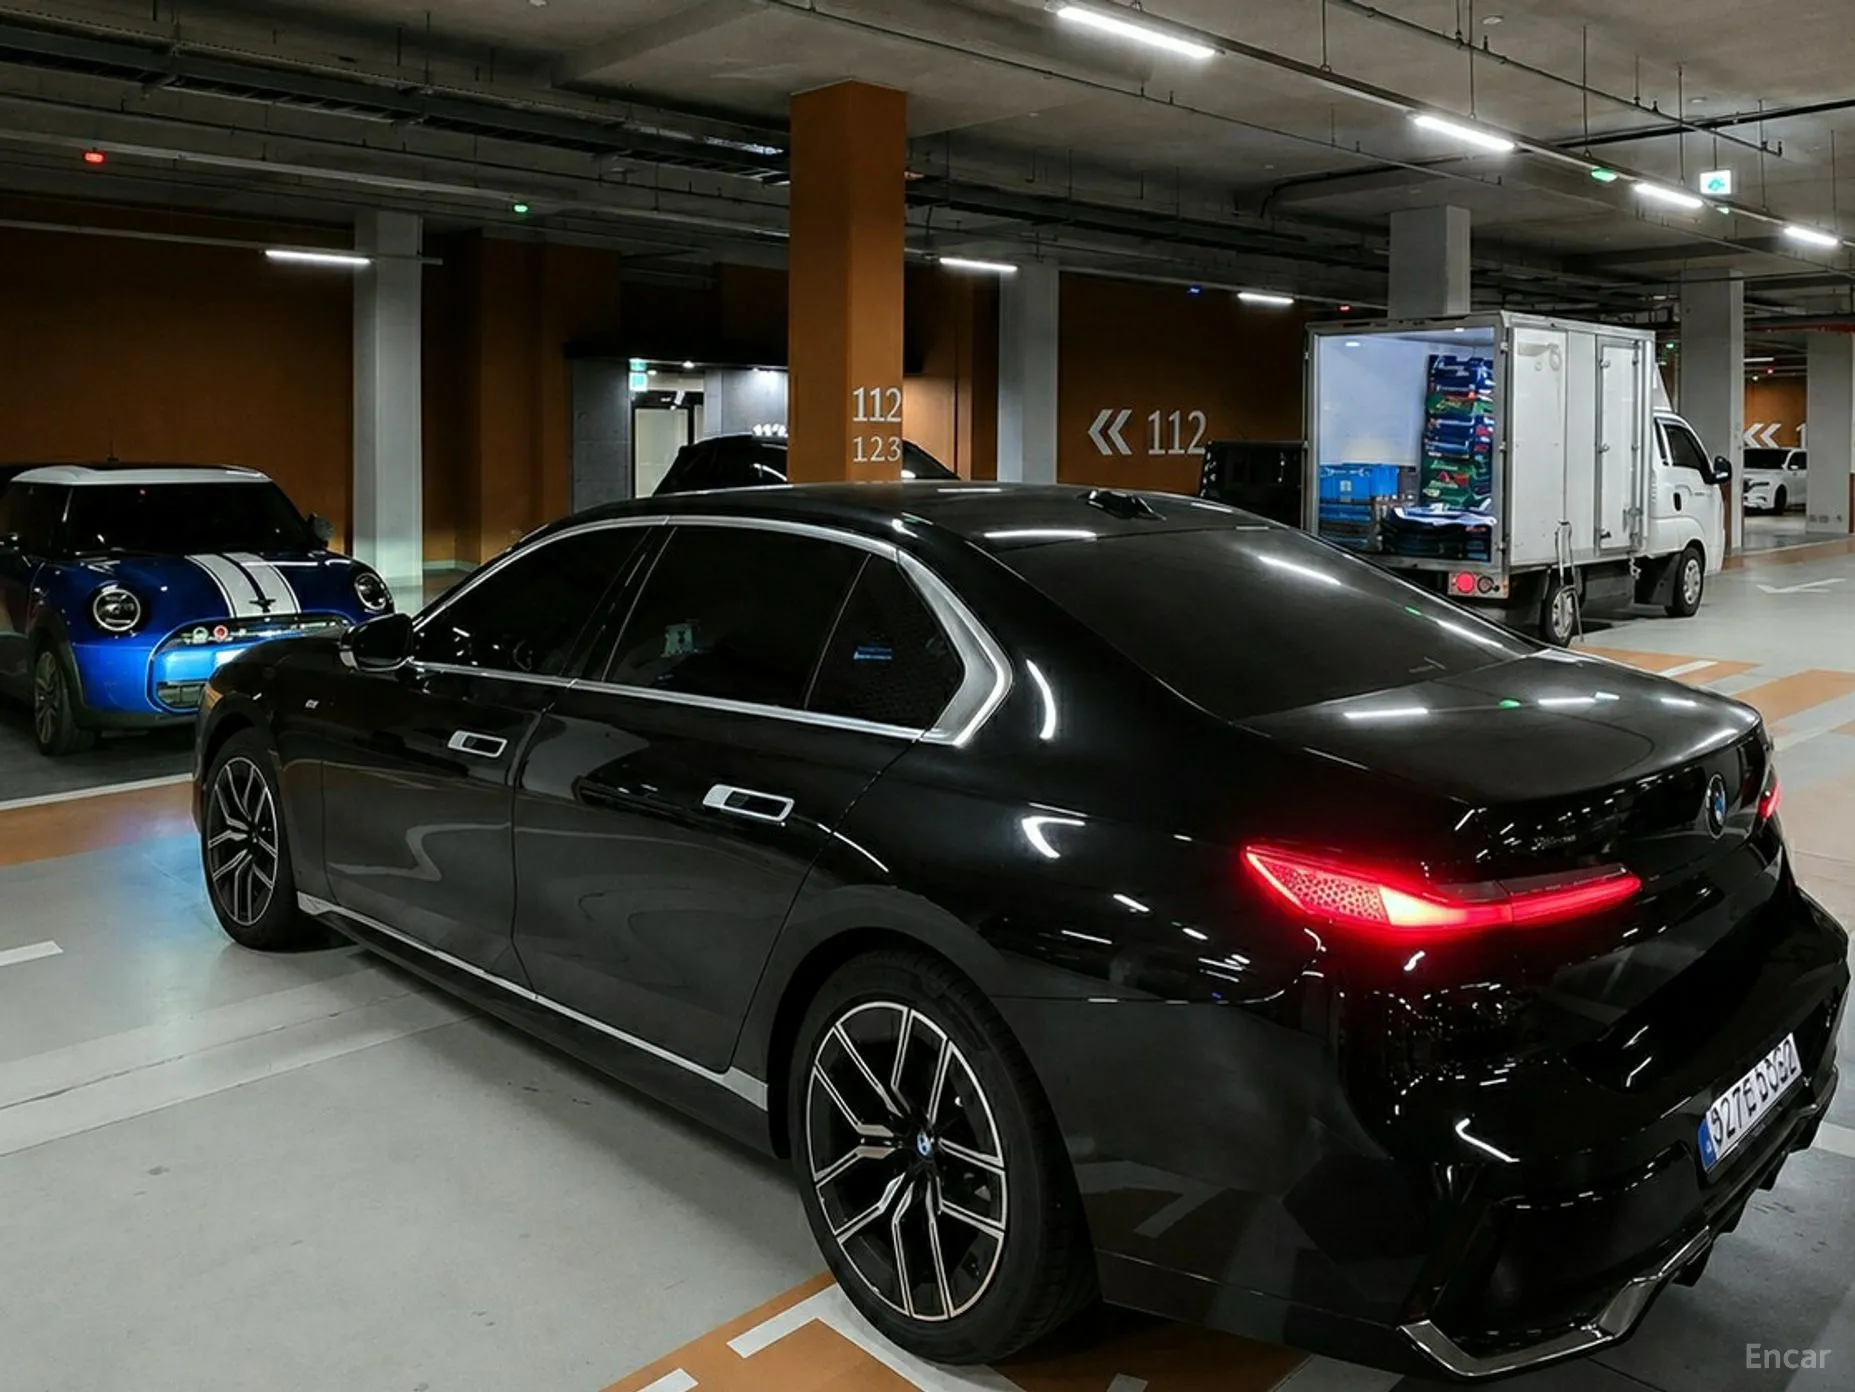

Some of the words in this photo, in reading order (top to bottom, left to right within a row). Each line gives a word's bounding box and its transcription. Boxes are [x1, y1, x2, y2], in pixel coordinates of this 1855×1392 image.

[853, 387, 902, 422] 112
[853, 436, 902, 462] 123
[1147, 409, 1207, 455] 112
